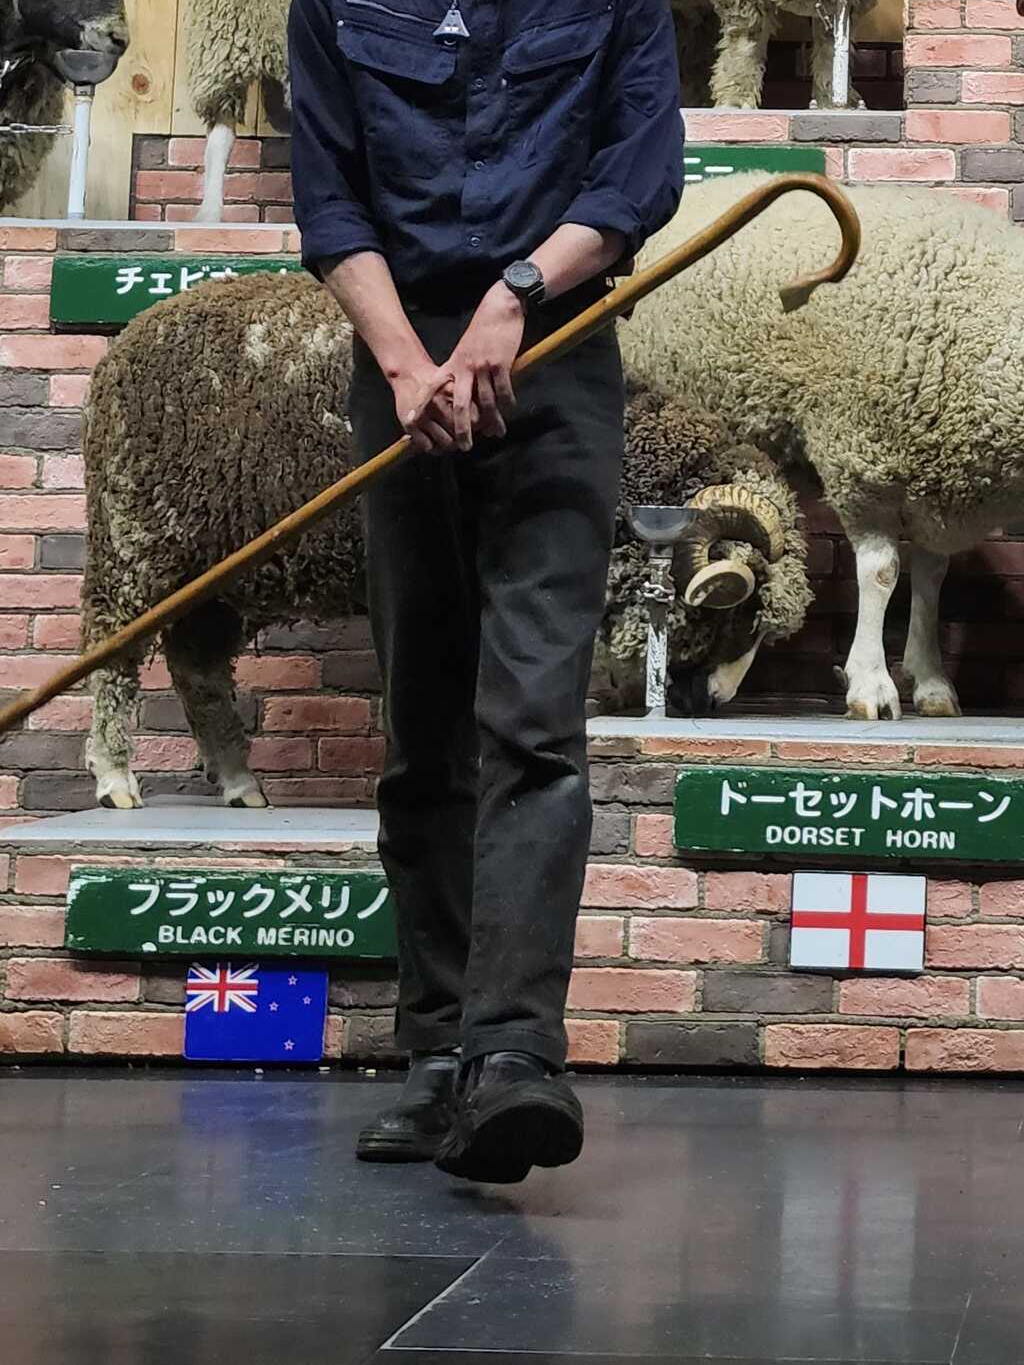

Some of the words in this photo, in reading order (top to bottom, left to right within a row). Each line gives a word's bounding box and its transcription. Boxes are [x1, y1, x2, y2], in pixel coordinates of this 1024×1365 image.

[720, 780, 1011, 822] ドーセットホーン
[765, 825, 866, 847] DORSET
[885, 829, 956, 849] HORN
[127, 880, 390, 920] ブラックメリノ
[158, 925, 243, 945] BLACK
[256, 927, 355, 947] MERINO
